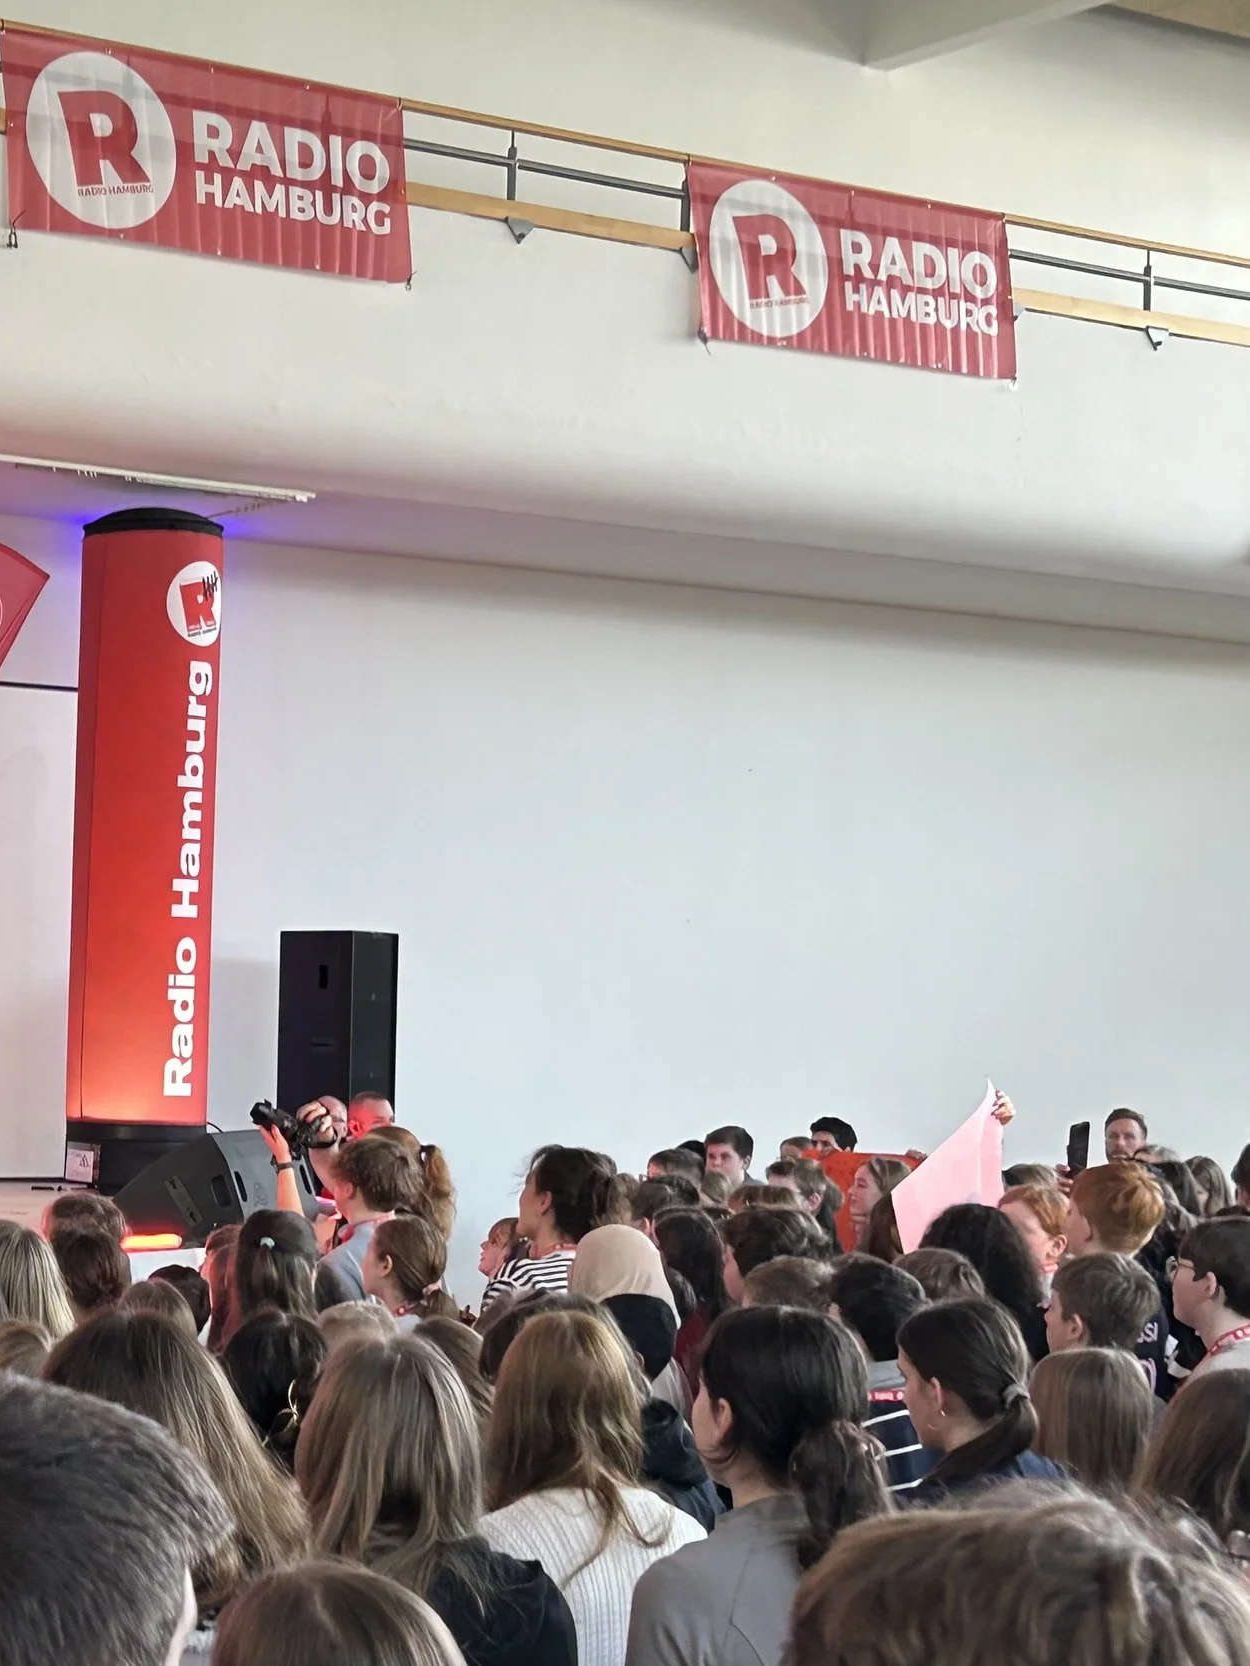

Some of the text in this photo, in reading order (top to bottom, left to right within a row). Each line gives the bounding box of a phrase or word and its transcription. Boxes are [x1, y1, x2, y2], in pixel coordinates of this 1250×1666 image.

[57, 90, 151, 187] R
[192, 110, 390, 194] RADIO
[110, 184, 154, 194] HAMBURG
[196, 170, 391, 235] HAMBURG
[732, 213, 806, 299] R
[840, 228, 997, 299] RADIO
[845, 281, 998, 336] HAMBURG
[170, 660, 213, 919] Hamburg
[162, 937, 199, 1098] Radio
